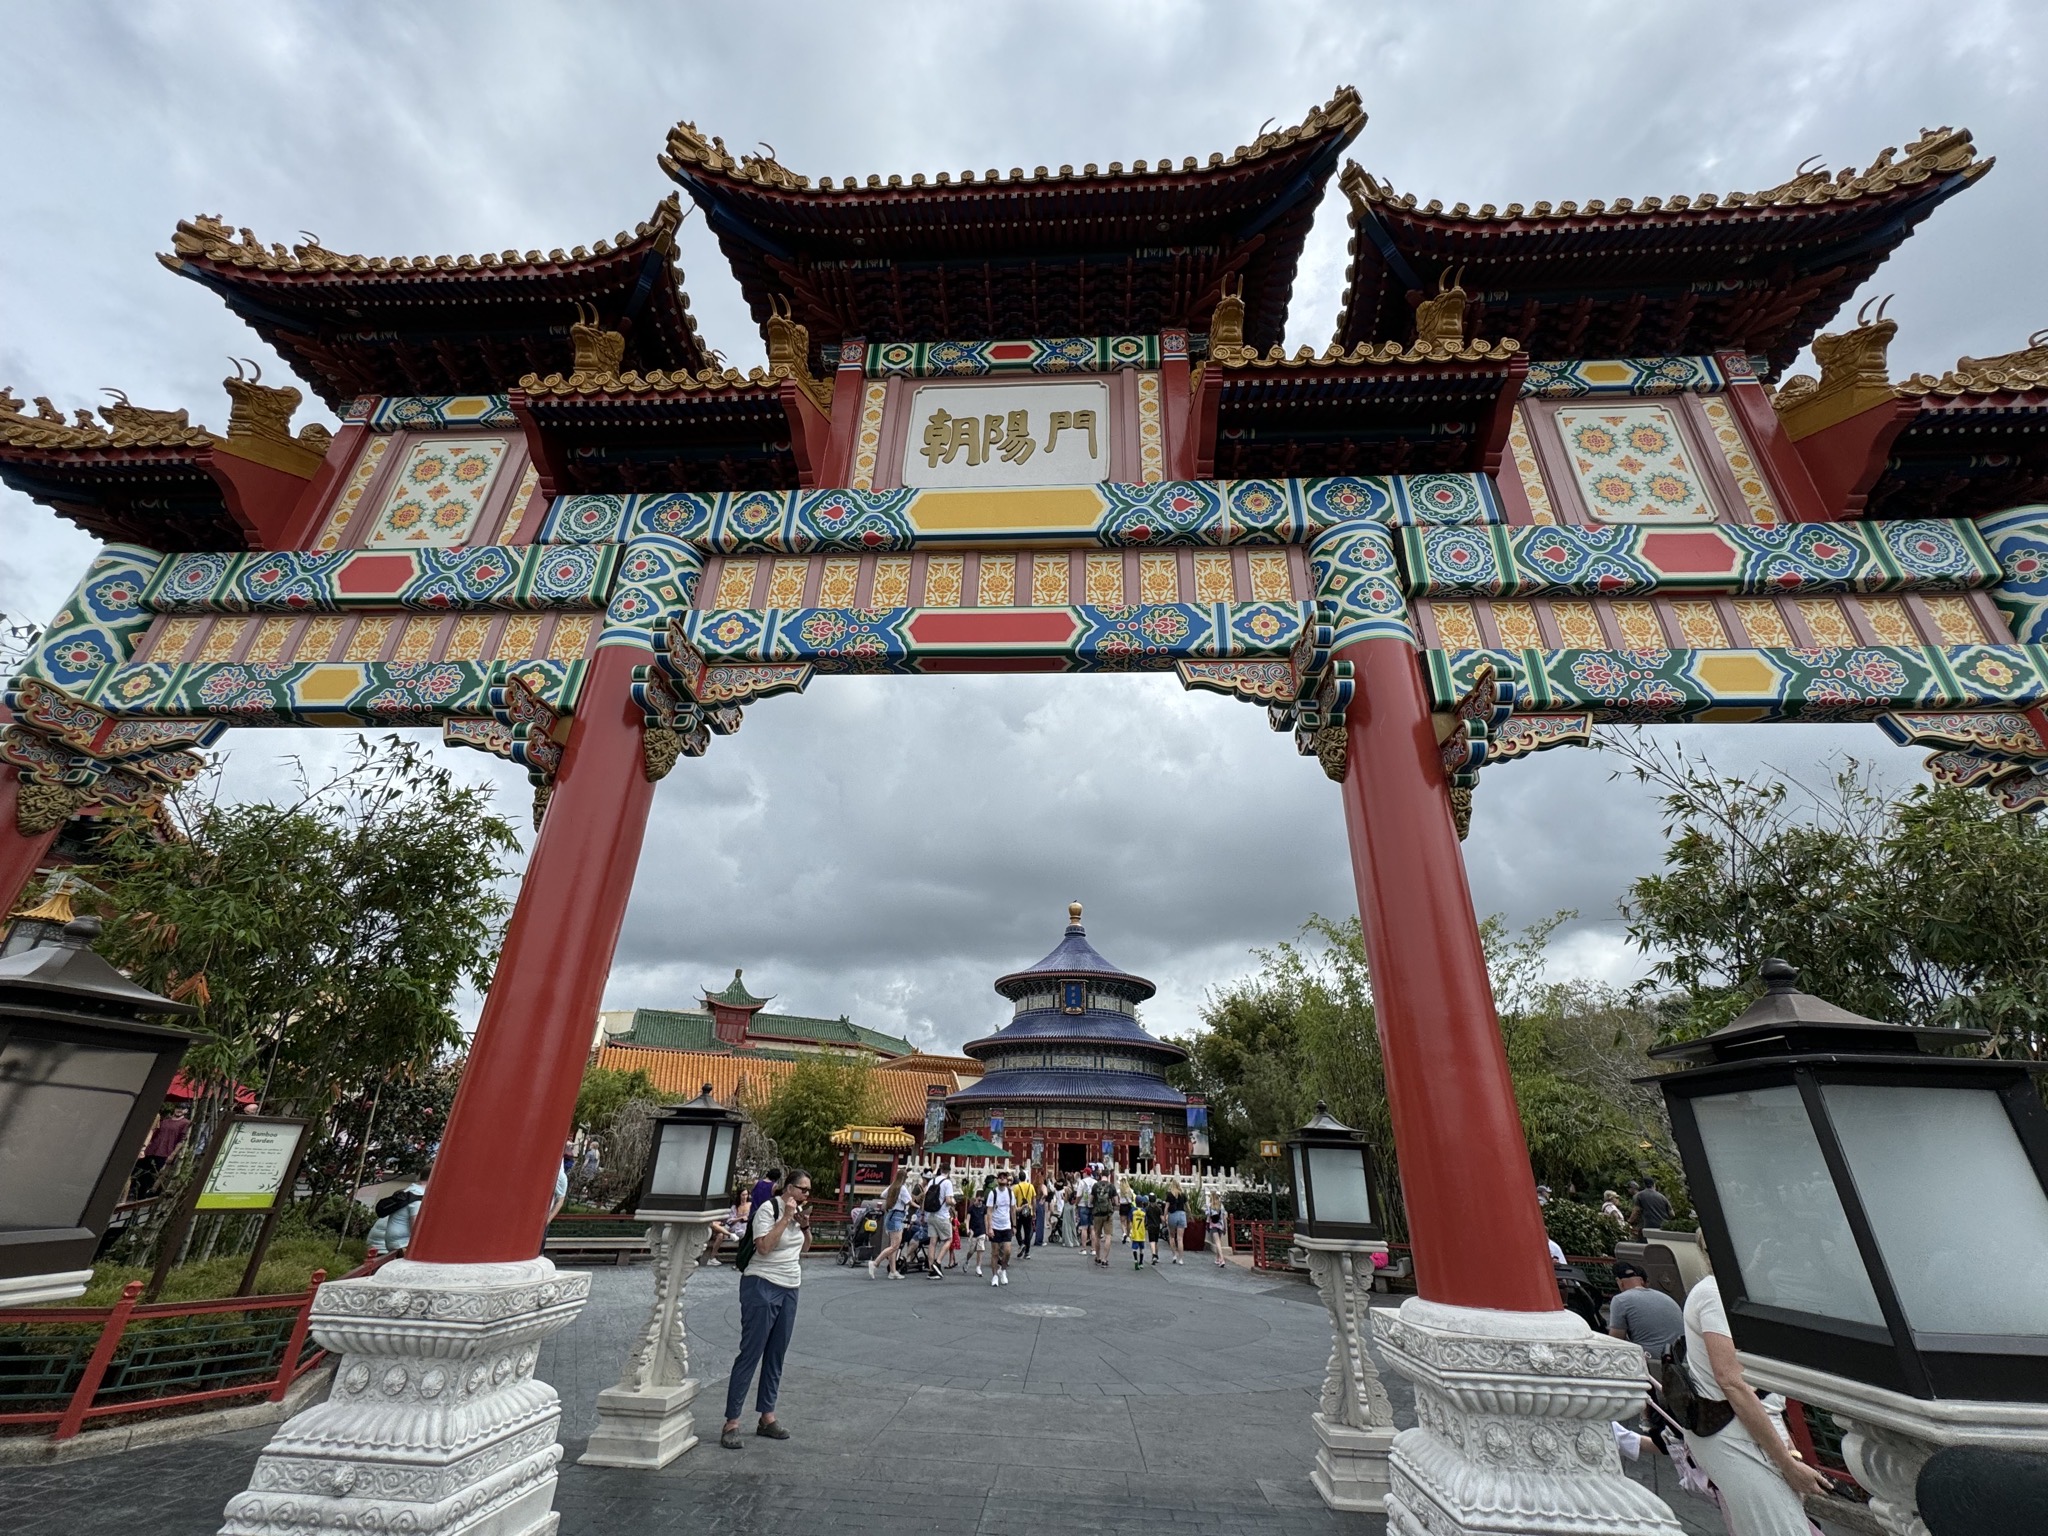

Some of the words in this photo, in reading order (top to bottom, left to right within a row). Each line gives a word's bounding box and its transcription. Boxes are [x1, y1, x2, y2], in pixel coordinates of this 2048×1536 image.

[920, 408, 1098, 468] 朝陽門
[854, 1168, 884, 1181] China
[1136, 1217, 1143, 1230] 7
